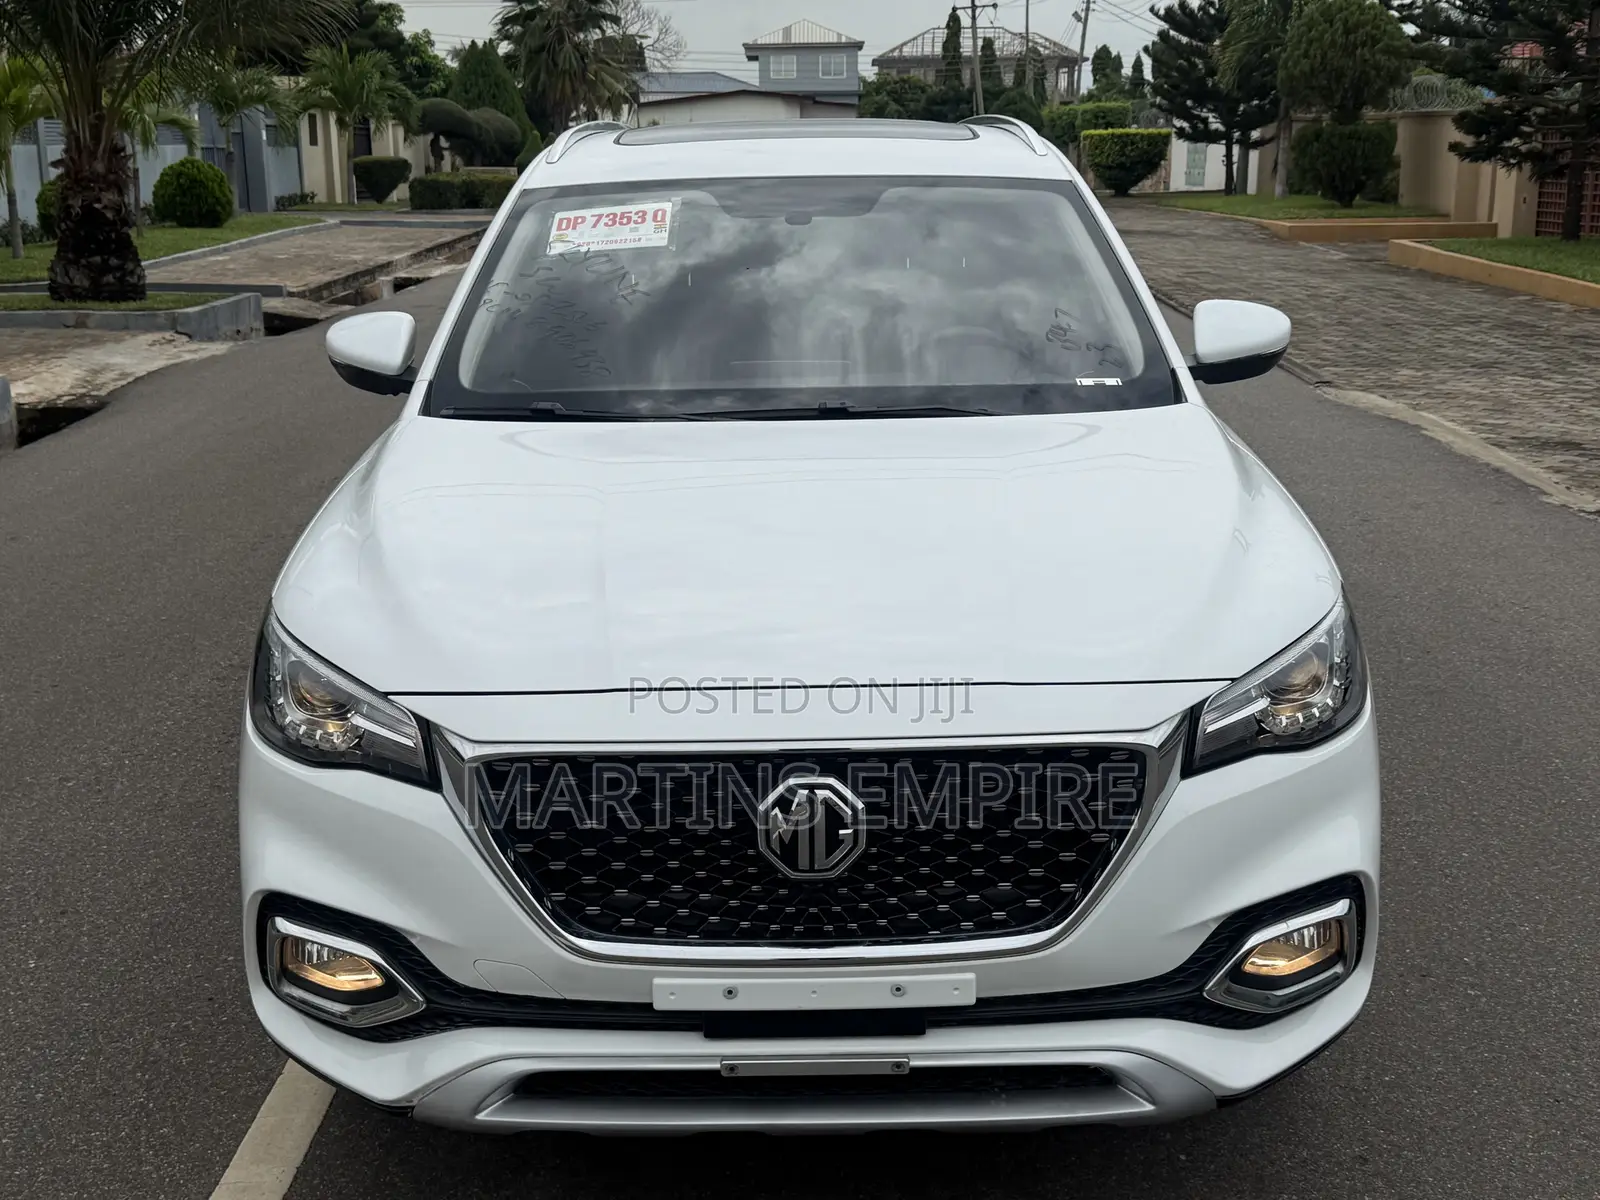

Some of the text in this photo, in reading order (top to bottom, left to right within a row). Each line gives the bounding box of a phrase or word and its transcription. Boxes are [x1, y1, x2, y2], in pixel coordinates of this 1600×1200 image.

[556, 215, 587, 232] DP
[590, 210, 648, 229] 7353
[769, 789, 855, 871] MG
